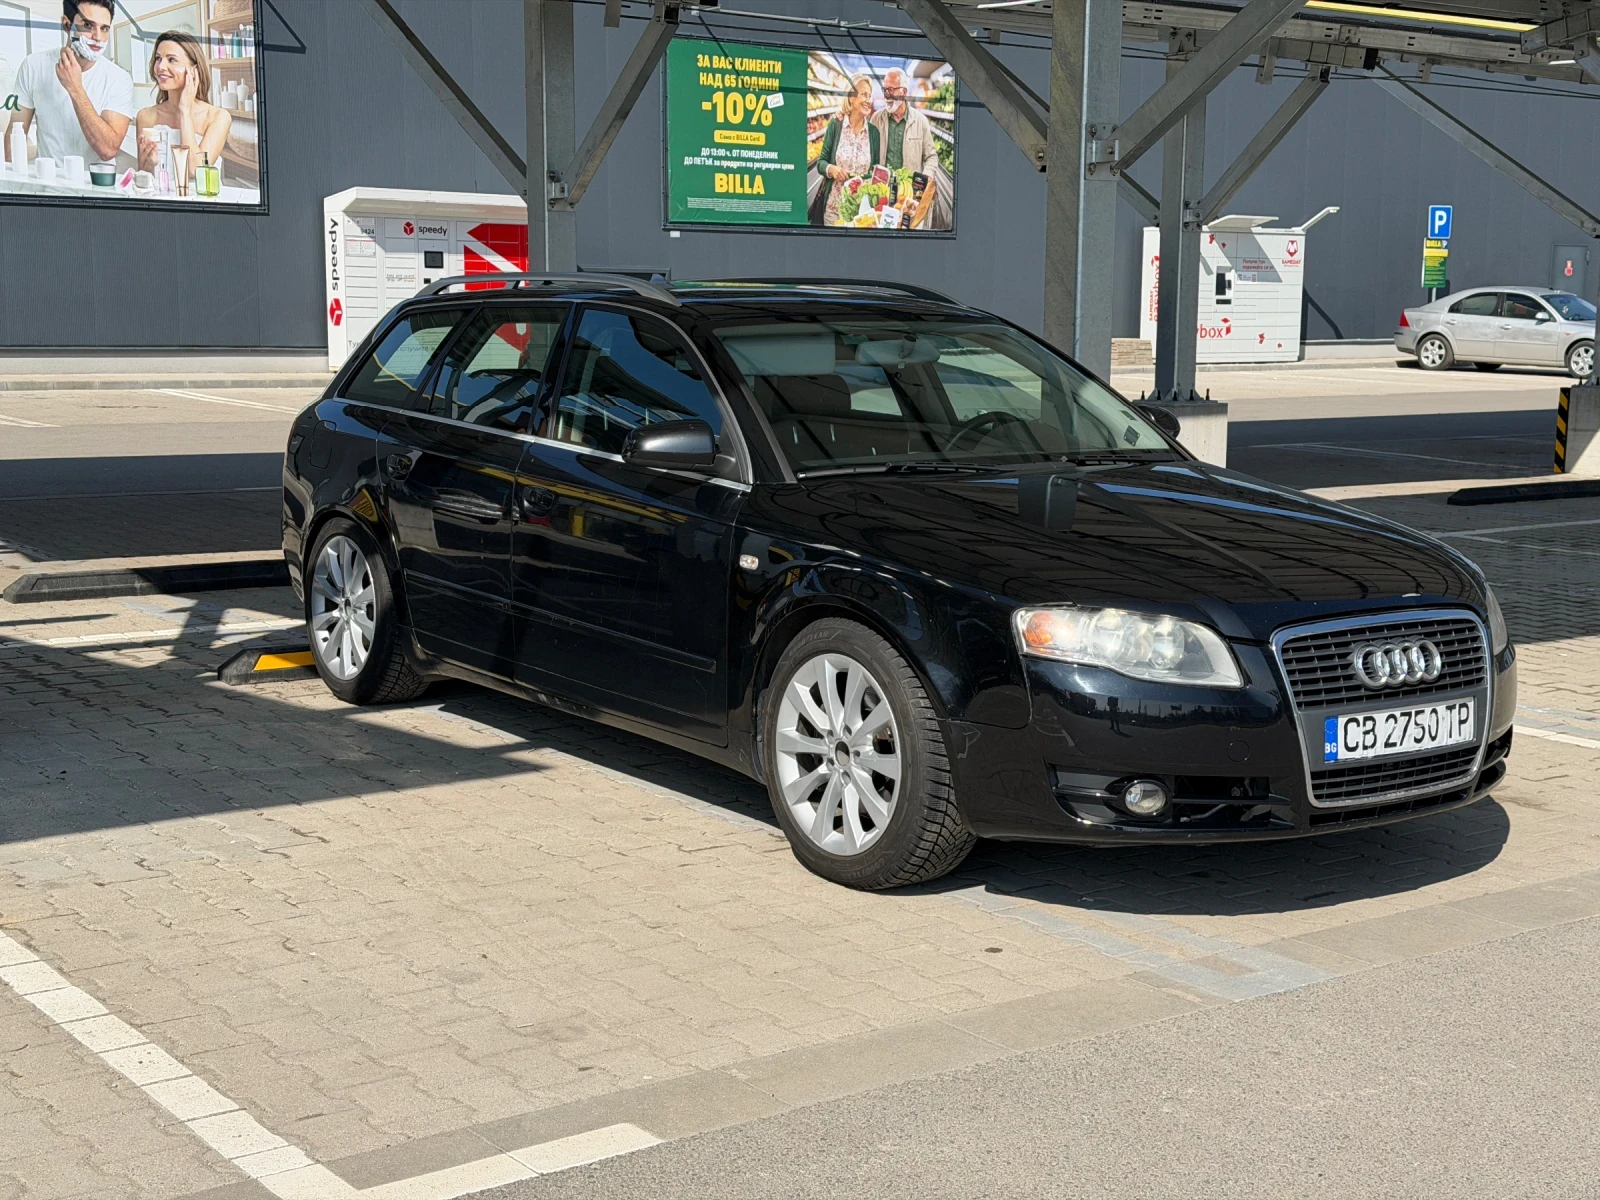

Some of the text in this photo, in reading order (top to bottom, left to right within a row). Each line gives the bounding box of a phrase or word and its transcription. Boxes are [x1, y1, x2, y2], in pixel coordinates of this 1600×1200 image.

[697, 54, 782, 74] ЗА ВАС КЛИЕНТИ
[699, 72, 780, 91] НАД 65 ГОДИНИ
[701, 91, 773, 126] -10%
[684, 156, 692, 166] ДО
[693, 157, 713, 165] ПЕТЪК
[701, 147, 710, 157] ДО
[710, 148, 726, 156] 13:00
[732, 149, 740, 157] ОТ
[740, 150, 779, 160] ПОНЕДЕЛНИК
[714, 172, 765, 194] BILLA
[418, 225, 447, 236] speedy
[1434, 210, 1447, 234] P
[328, 218, 340, 291] speedy
[1343, 702, 1470, 752] CB 2750 TP
[1324, 742, 1337, 753] BG
